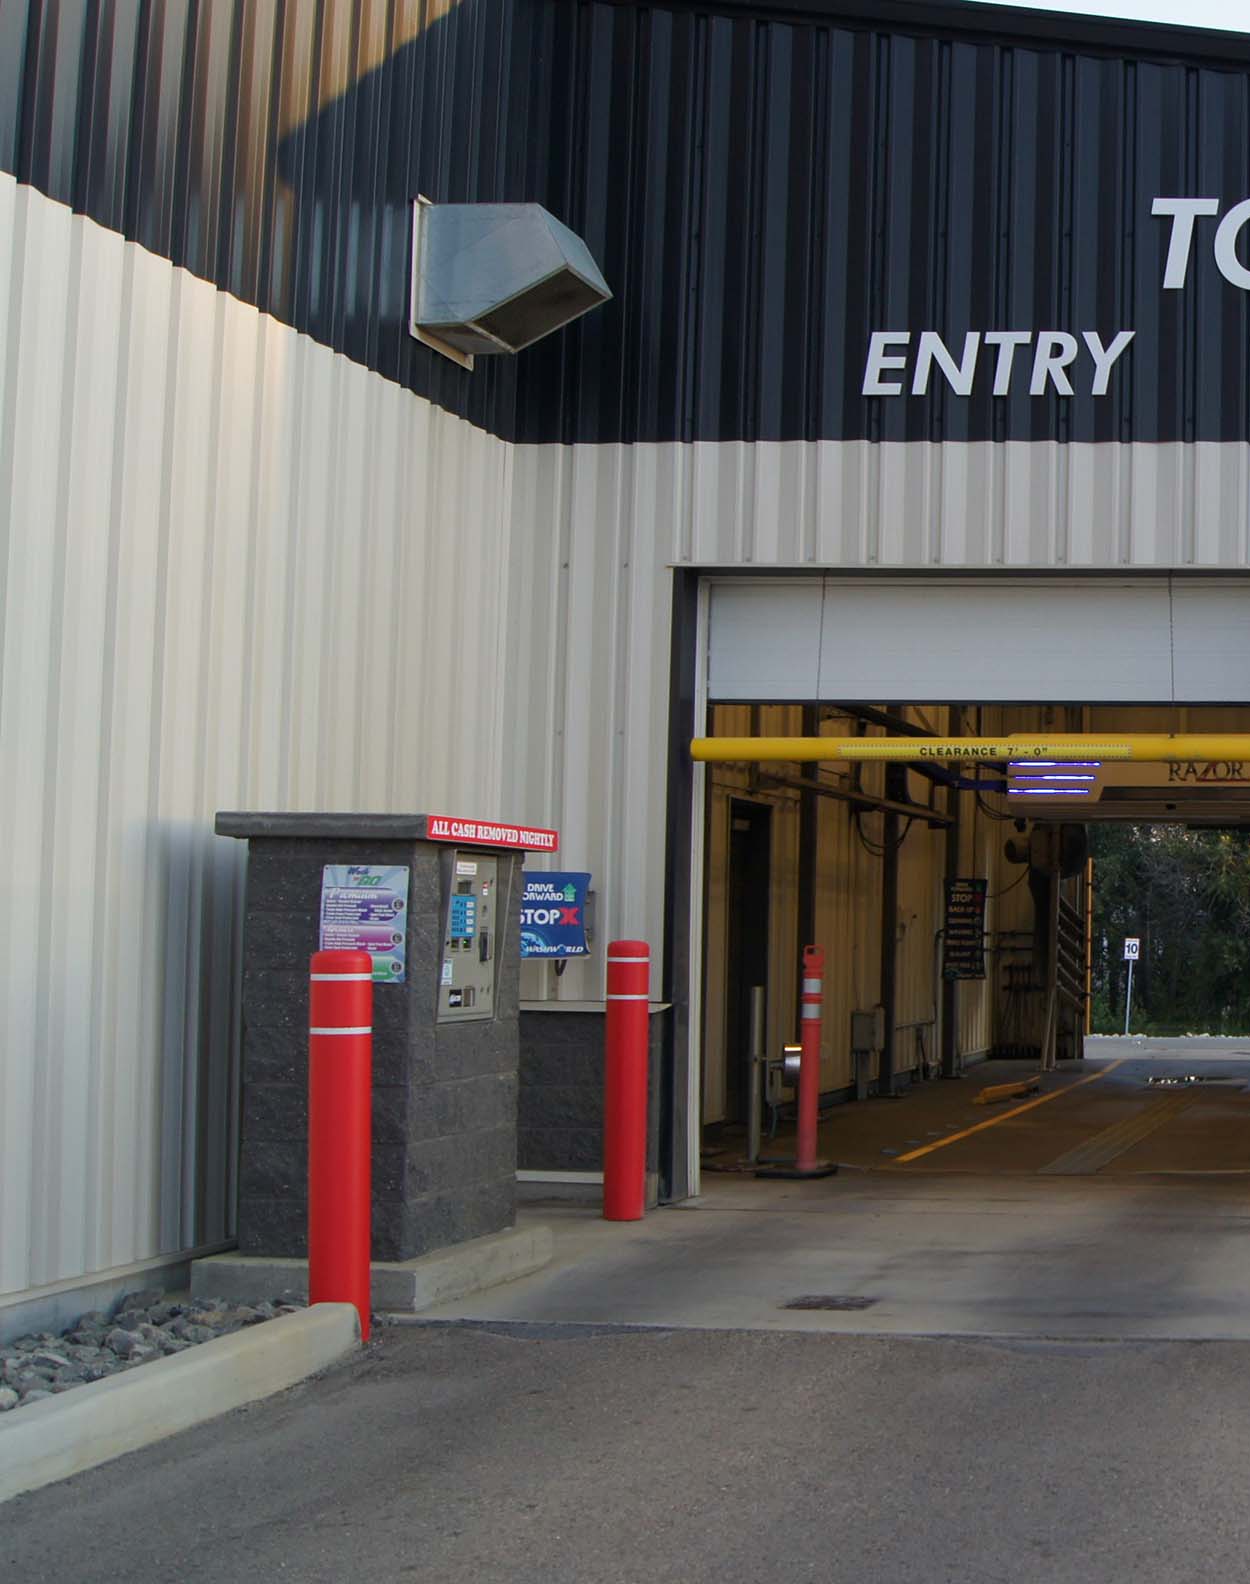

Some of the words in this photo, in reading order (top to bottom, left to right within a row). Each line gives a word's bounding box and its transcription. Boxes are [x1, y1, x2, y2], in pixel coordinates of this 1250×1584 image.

[862, 331, 1136, 395] ENTRY
[920, 747, 997, 756] CLEARANCE
[1007, 747, 1018, 756] 7'
[431, 820, 450, 835] ALL
[451, 822, 476, 838] CASH
[477, 825, 518, 843] REMOVED
[520, 830, 555, 847] NIGHTLY
[527, 883, 554, 892] DRIVE
[522, 892, 564, 901] ORWARD
[951, 894, 973, 902] STOP
[1126, 943, 1138, 954] 10
